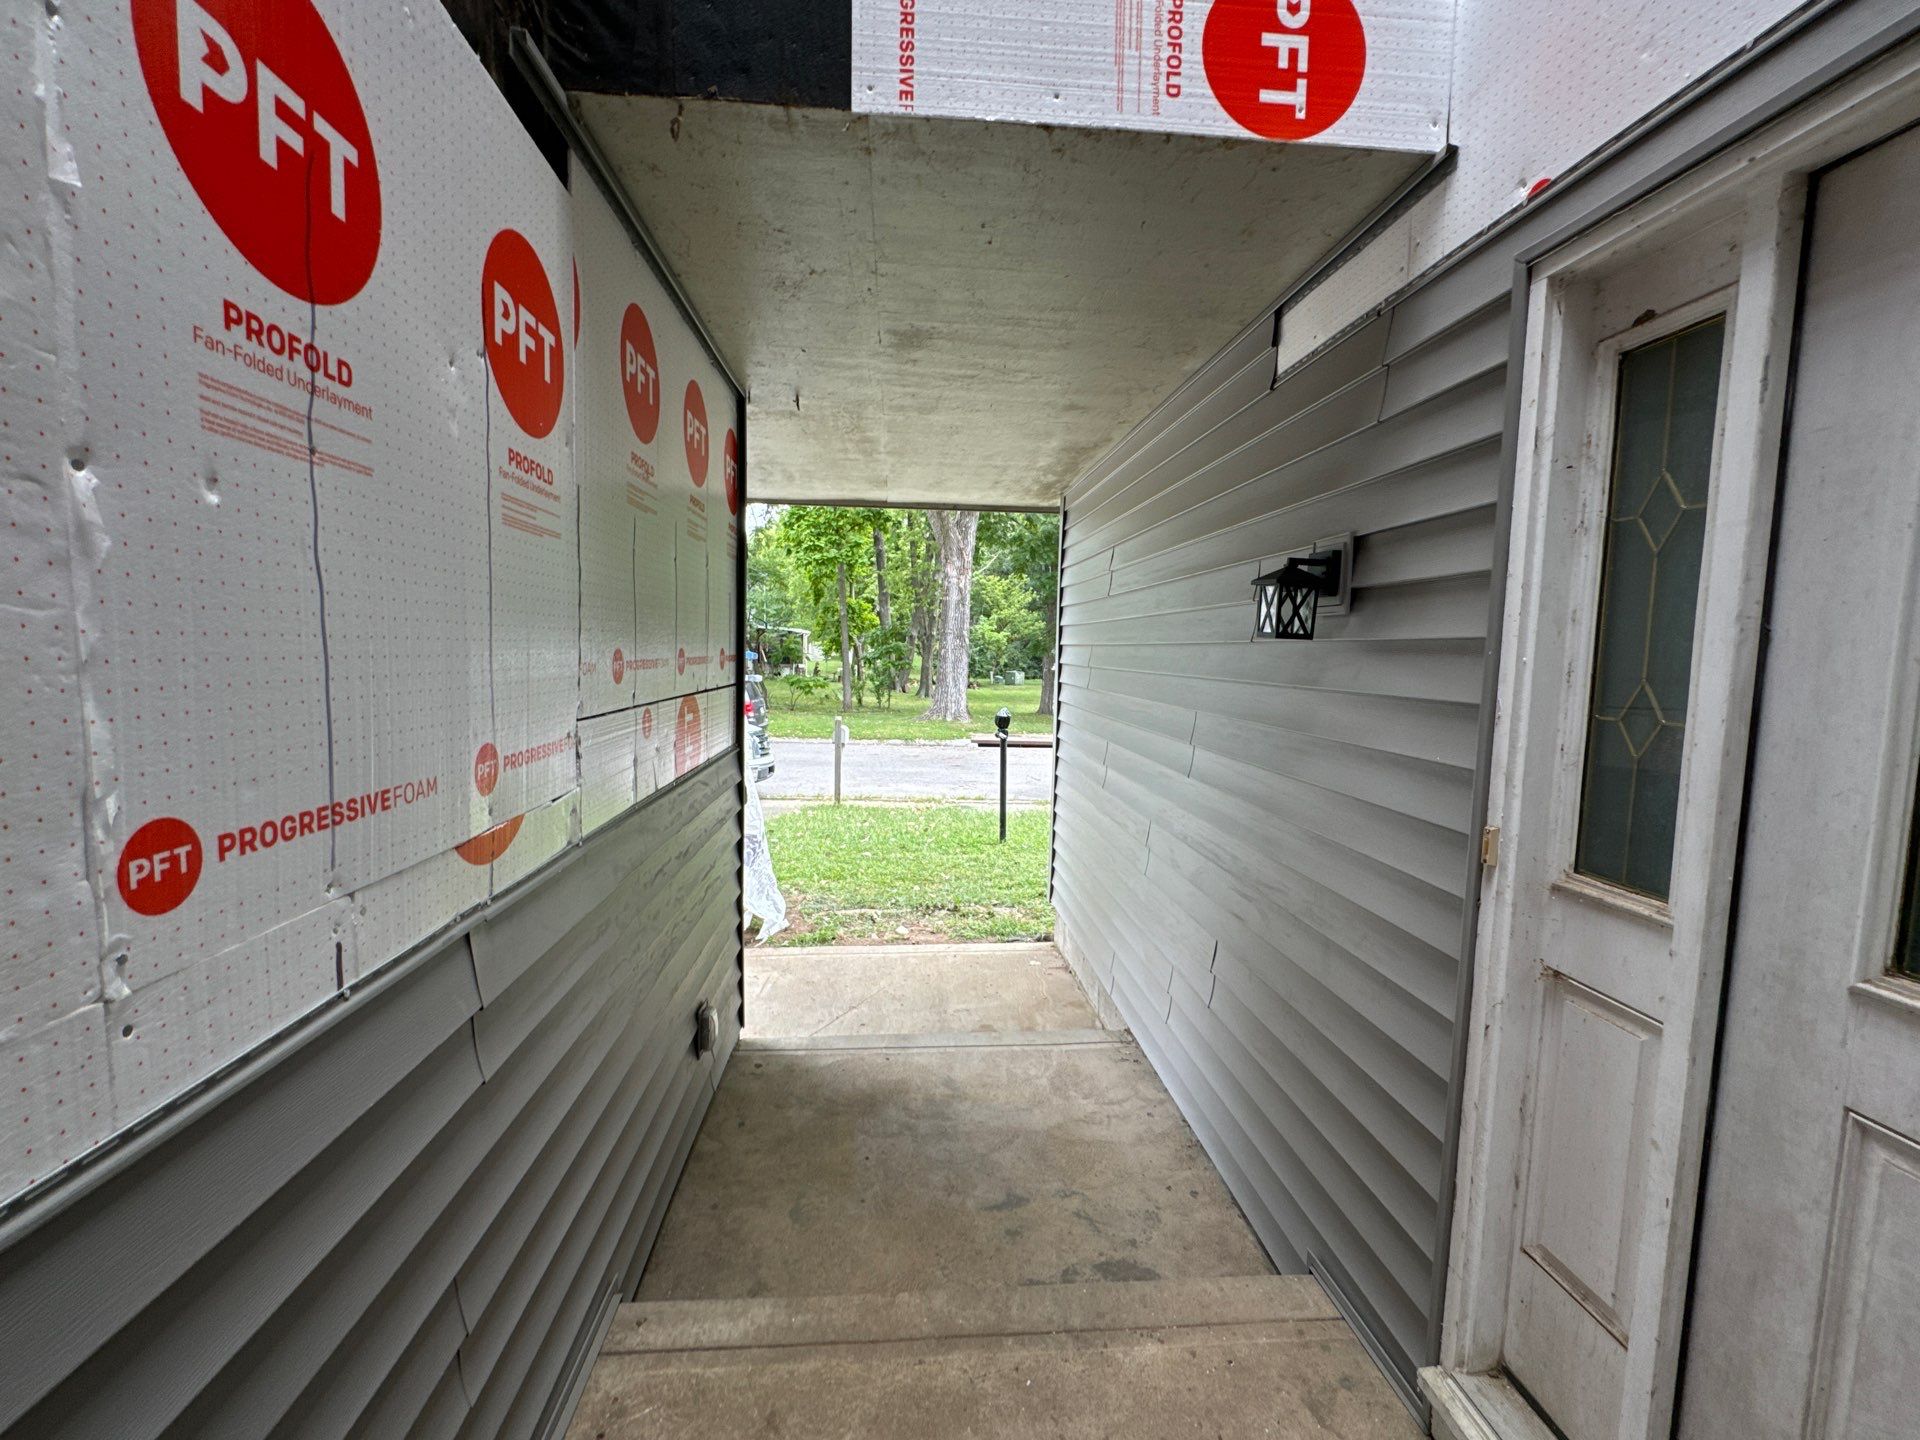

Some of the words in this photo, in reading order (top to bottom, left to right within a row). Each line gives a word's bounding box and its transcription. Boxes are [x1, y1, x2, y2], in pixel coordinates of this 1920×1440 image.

[177, 0, 359, 223] PFT
[193, 325, 284, 382] Fan-Folded
[287, 369, 374, 421] Underlayment
[223, 298, 353, 388] PROFOLD
[494, 280, 556, 385] PFT
[626, 340, 656, 406] PFT
[508, 447, 554, 487] PROFOLD
[686, 409, 707, 457] PFT
[478, 759, 498, 778] PFT
[128, 844, 193, 891] PFT
[217, 776, 439, 862] PROGRESSIVEFOAM
